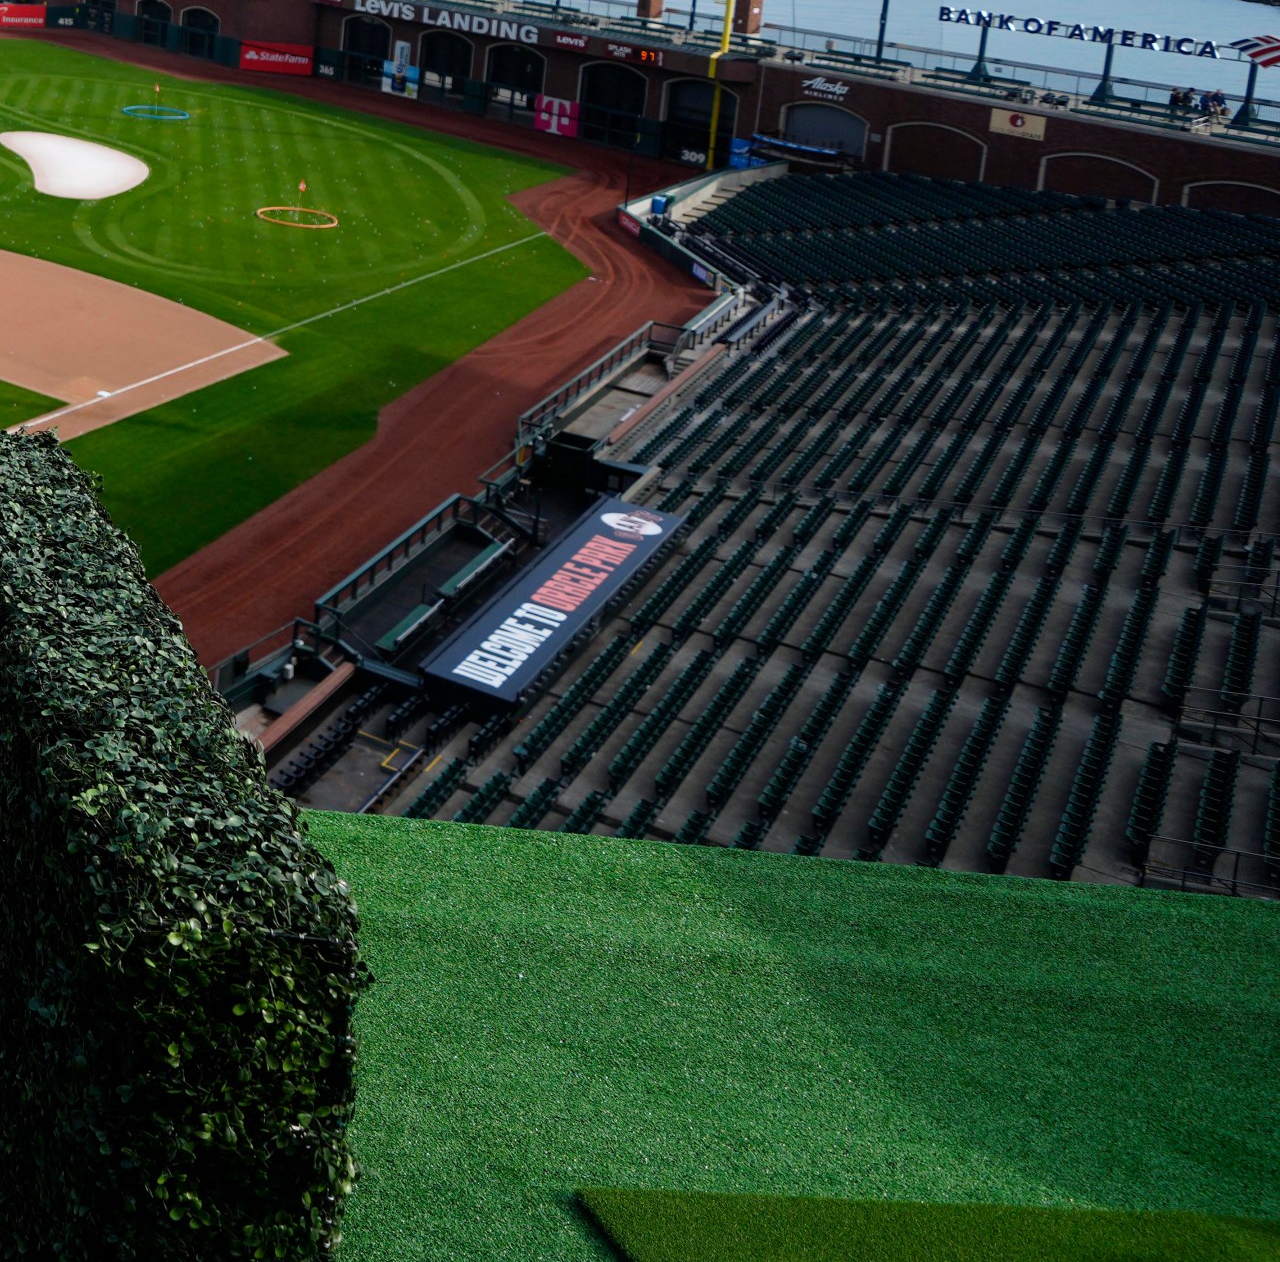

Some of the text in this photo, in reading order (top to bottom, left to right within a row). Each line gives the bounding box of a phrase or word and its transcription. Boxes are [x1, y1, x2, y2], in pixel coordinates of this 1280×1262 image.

[2, 15, 44, 24] Insurance
[58, 18, 74, 26] 415
[423, 7, 539, 44] LANDING
[939, 5, 1221, 60] BANK OF AMERICA
[608, 44, 632, 54] SPLASH
[320, 65, 334, 76] 365
[801, 76, 849, 95] Alaska
[681, 149, 706, 164] 309
[452, 534, 638, 688] WELCOME TO ORACLE PARK
